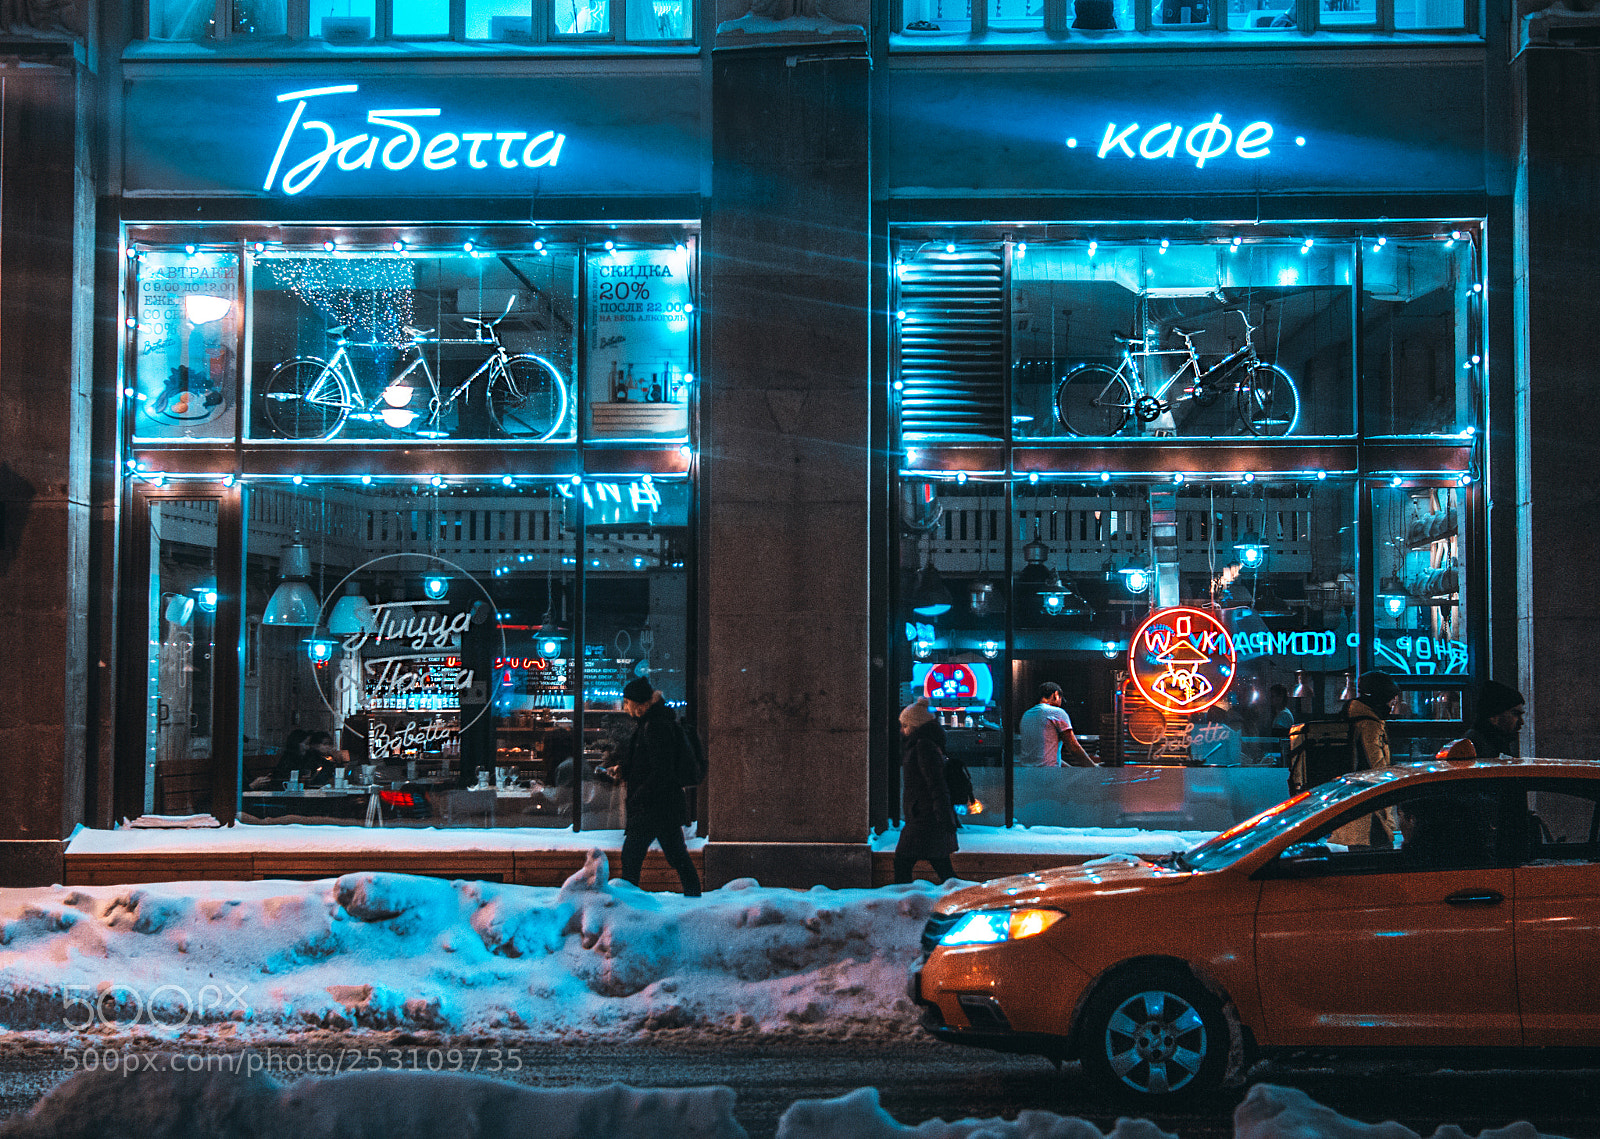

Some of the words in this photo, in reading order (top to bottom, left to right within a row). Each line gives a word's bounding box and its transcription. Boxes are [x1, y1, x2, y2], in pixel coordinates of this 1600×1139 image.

[262, 84, 566, 195] Бабетта
[1097, 112, 1274, 169] кафе
[145, 266, 236, 279] АВТРАКИ
[600, 265, 673, 280] СКИДКА
[143, 283, 151, 292] С
[153, 283, 180, 292] 9.00
[183, 283, 200, 293] ДО
[204, 283, 235, 292] 12.00
[600, 282, 650, 300] 20%
[600, 303, 643, 313] ПОСЛЕ
[647, 302, 682, 312] 22.00
